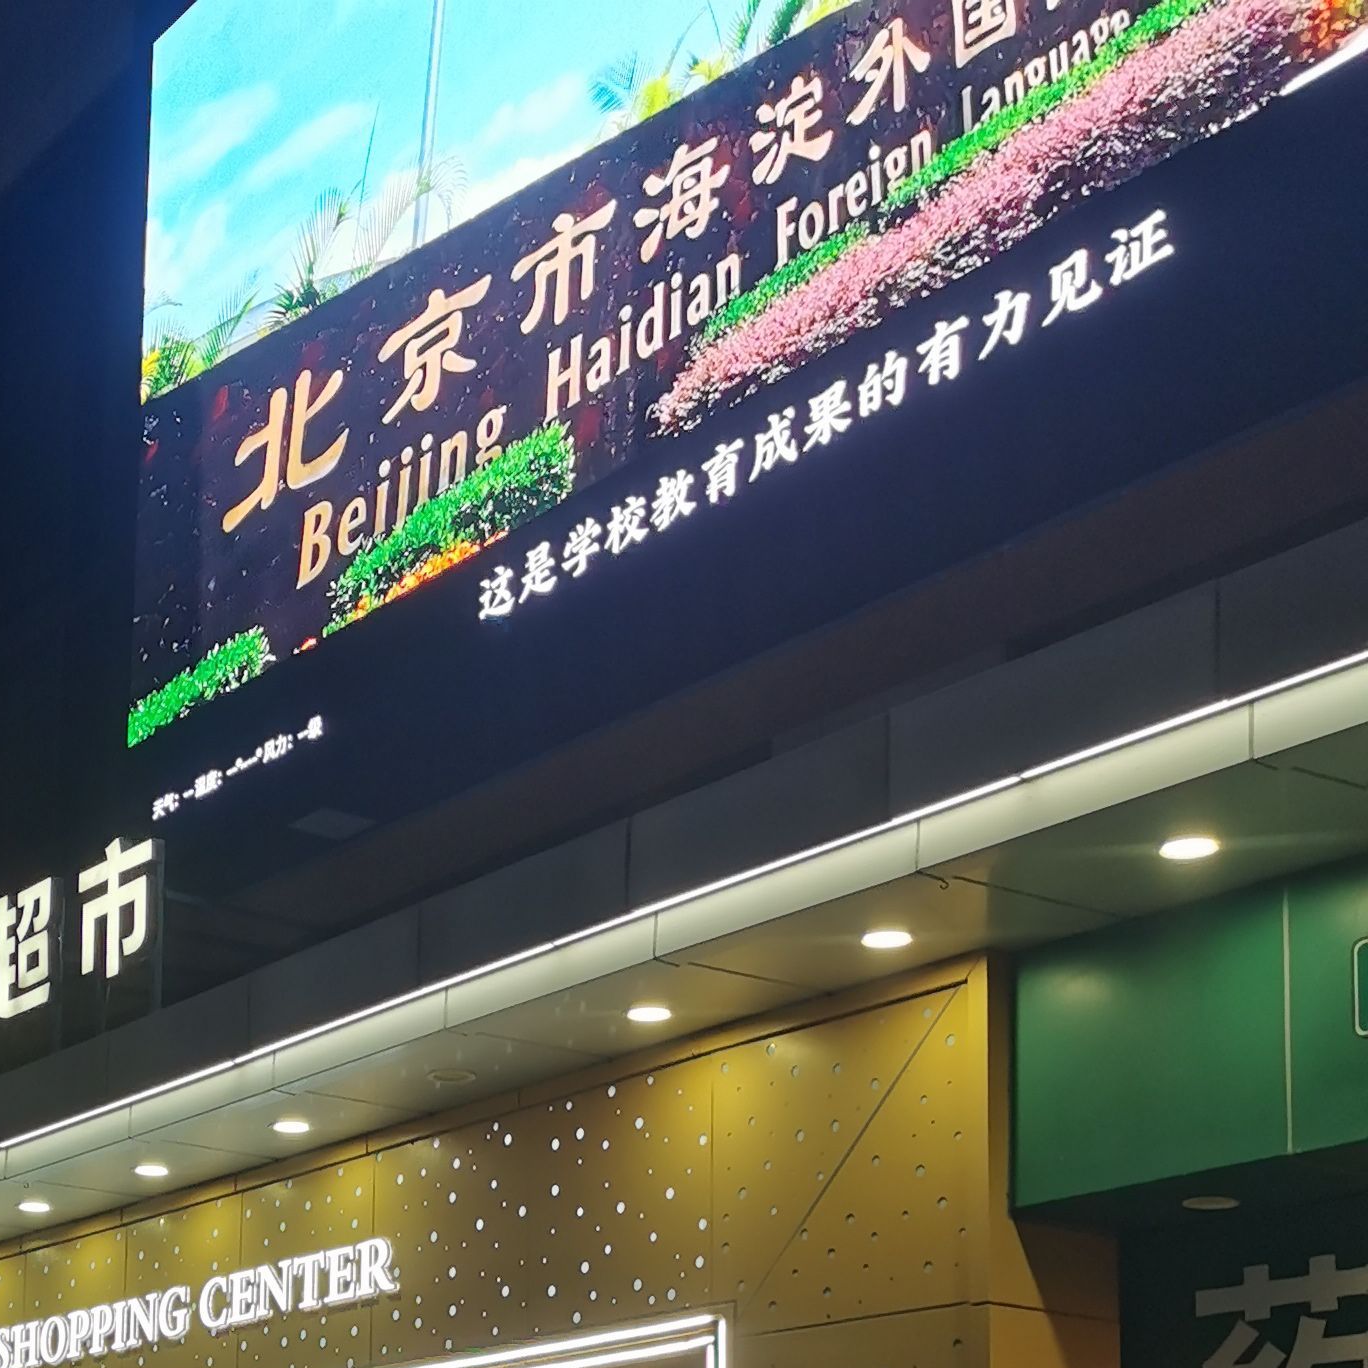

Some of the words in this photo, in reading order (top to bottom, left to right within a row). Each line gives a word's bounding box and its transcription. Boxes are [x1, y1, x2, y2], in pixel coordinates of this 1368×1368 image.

[222, 0, 1060, 533] 北京市海淀外国
[296, 405, 508, 590] Beijing
[544, 252, 742, 426] Haidian
[774, 129, 934, 272] Foreign
[478, 209, 1176, 622] 这是学校教育成果的有力见证
[198, 1236, 400, 1331] CENTER
